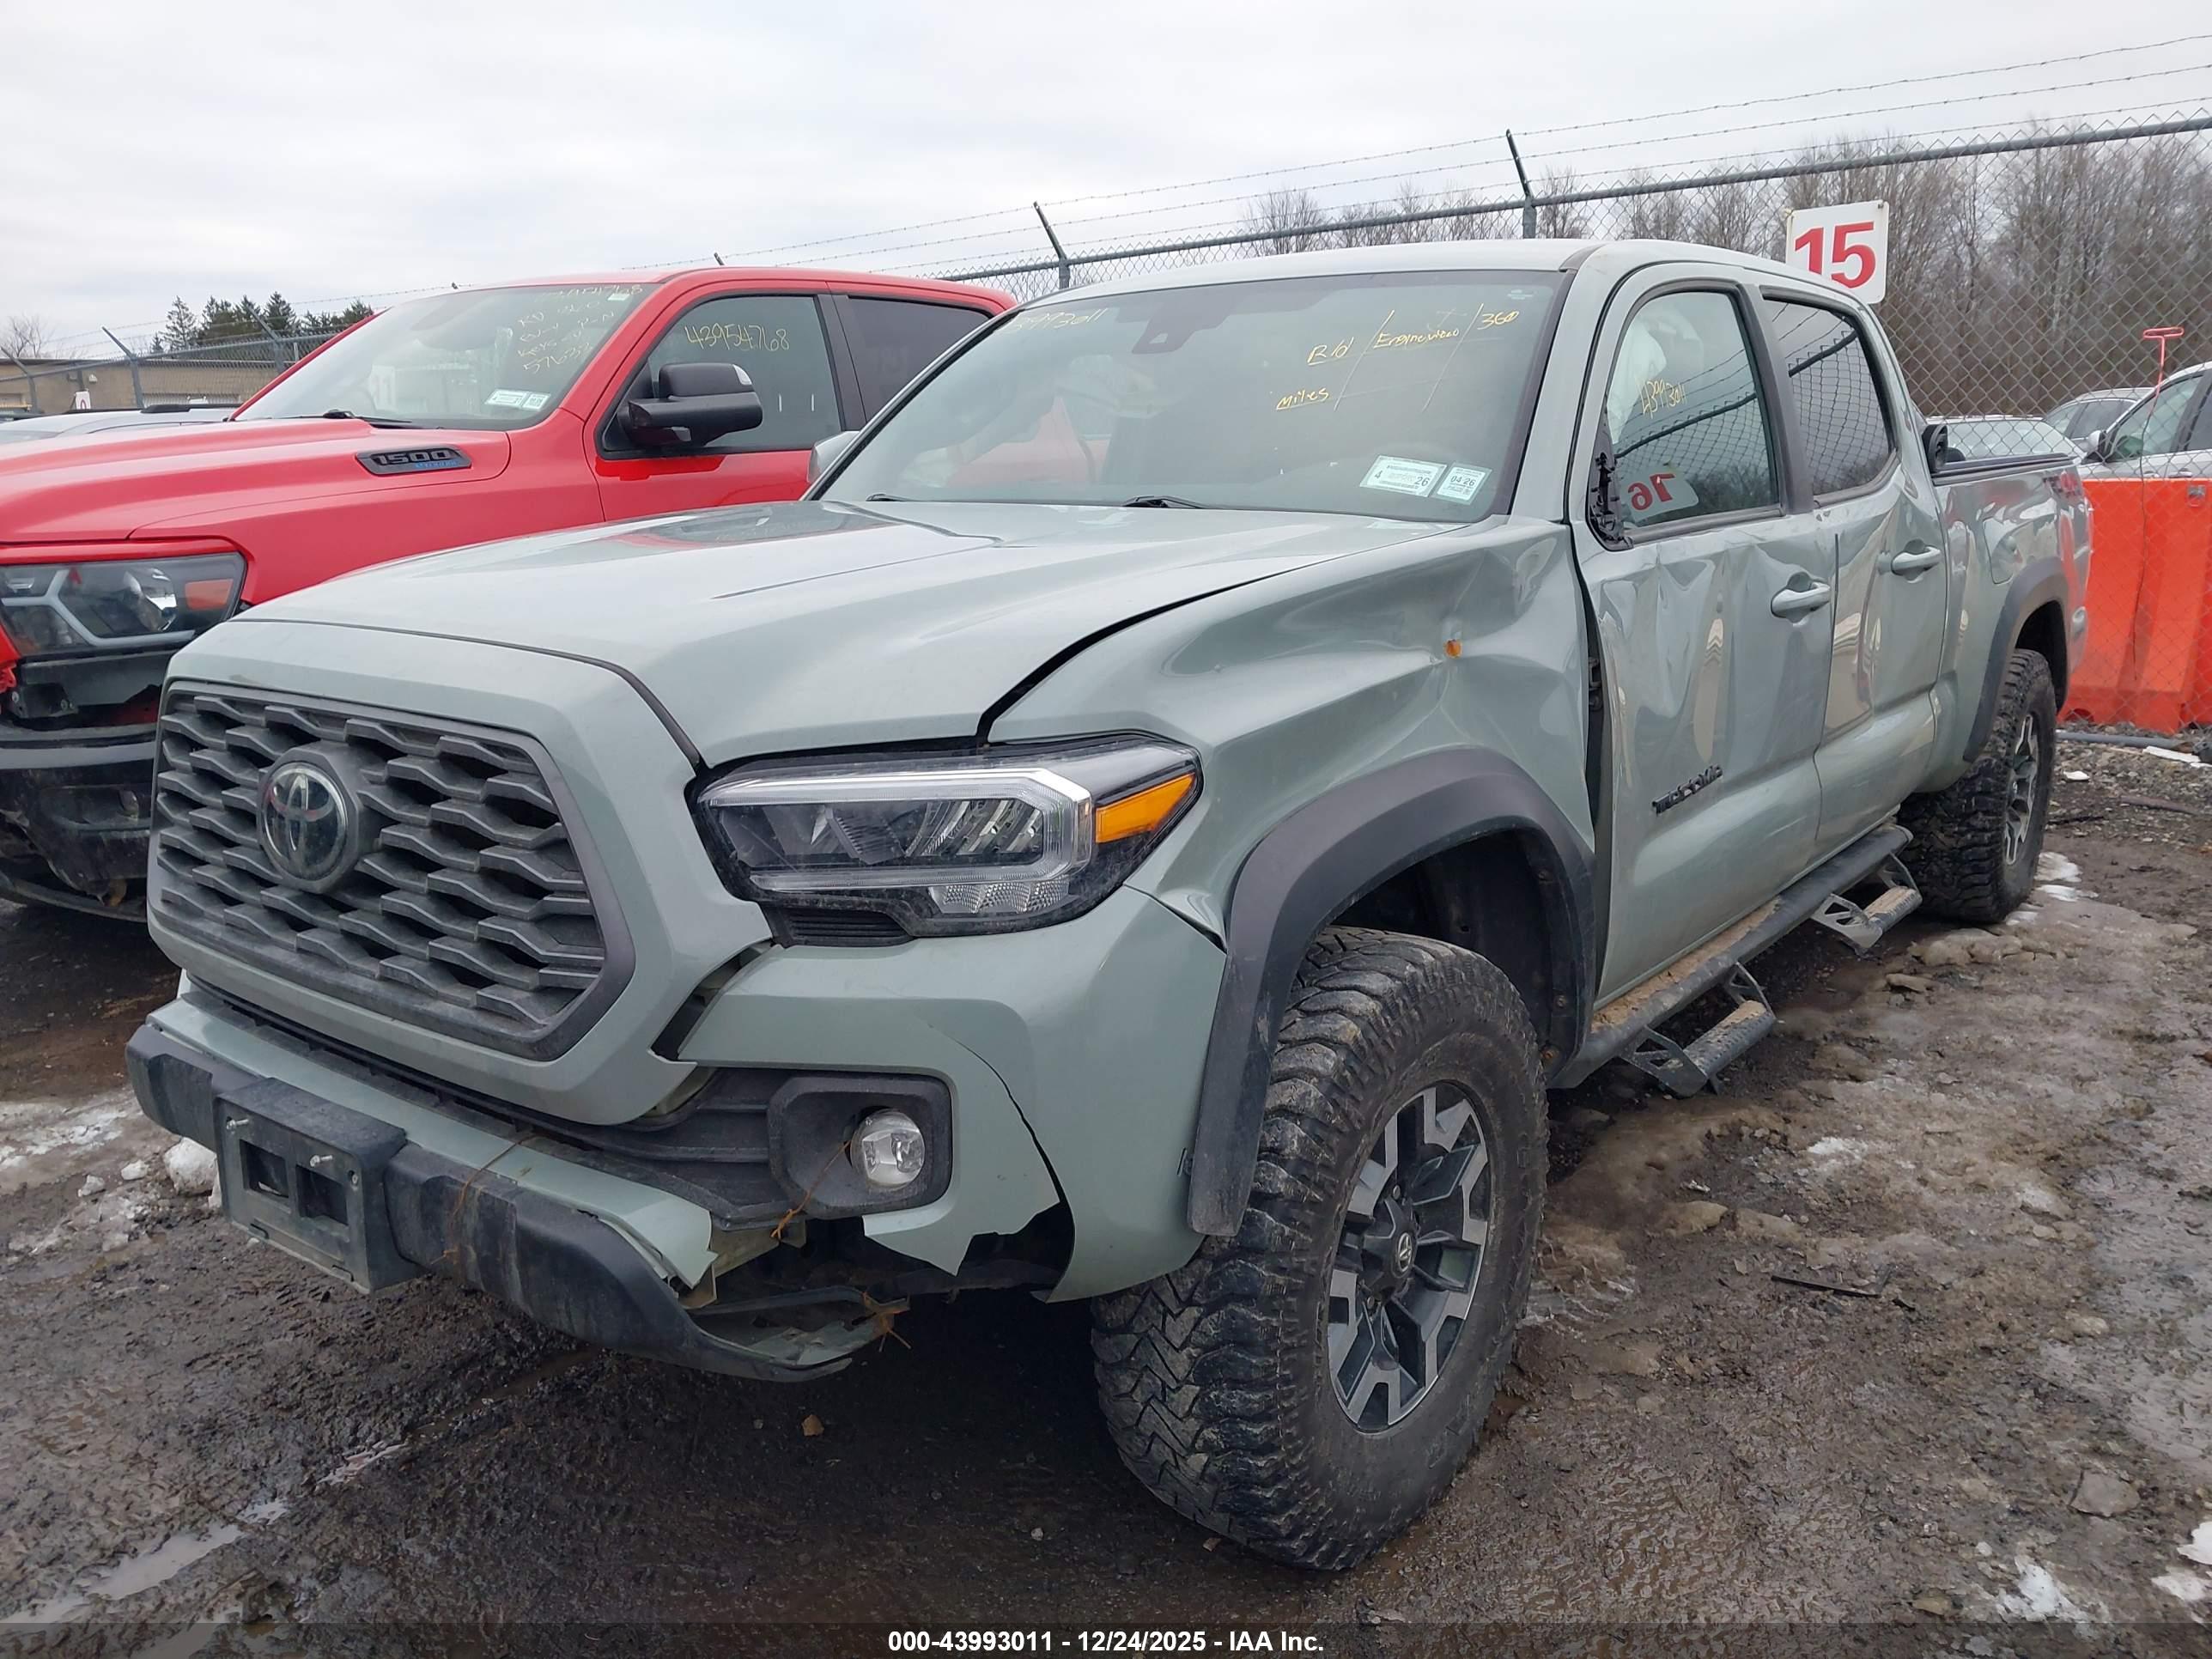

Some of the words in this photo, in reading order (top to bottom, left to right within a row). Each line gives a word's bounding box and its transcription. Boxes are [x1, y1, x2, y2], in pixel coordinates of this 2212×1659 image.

[1795, 221, 1876, 289] 15
[378, 449, 452, 465] 1500
[1416, 476, 1431, 487] 26
